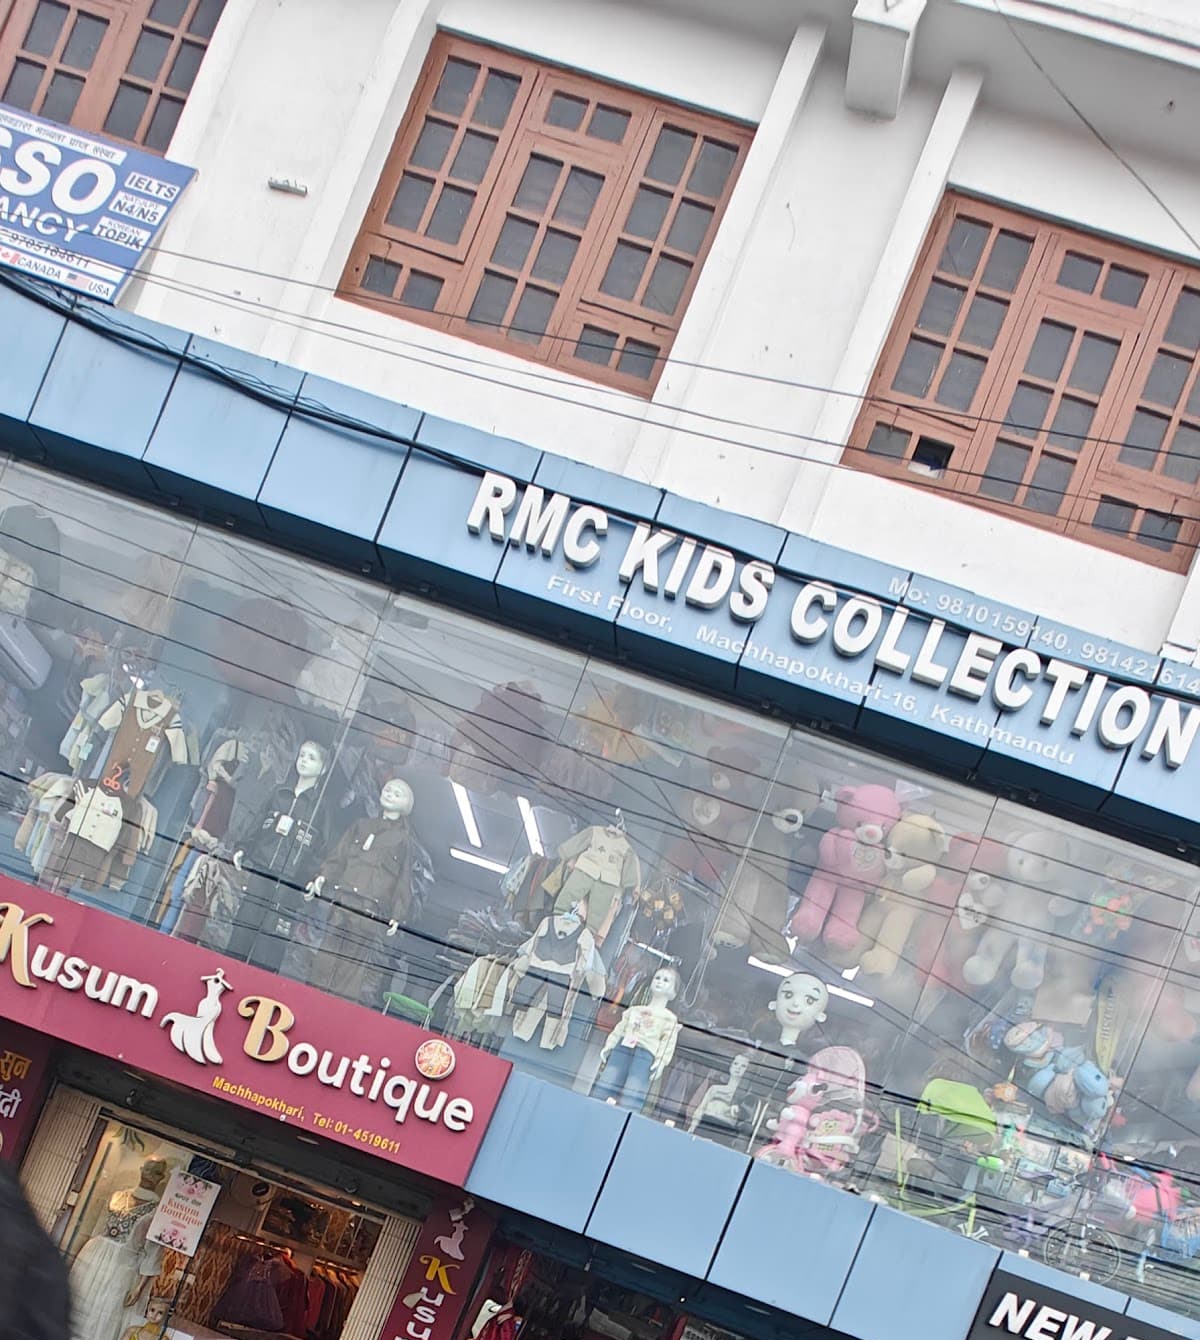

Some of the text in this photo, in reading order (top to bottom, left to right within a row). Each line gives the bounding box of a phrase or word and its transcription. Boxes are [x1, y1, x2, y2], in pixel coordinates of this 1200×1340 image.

[127, 173, 178, 199] IELTS
[112, 200, 160, 223] N4/N5
[97, 224, 144, 249] TOPIK
[17, 257, 110, 297] CANADA USA
[888, 576, 932, 605] Mo:
[466, 470, 1200, 769] RMC KIDS COLLECTION
[547, 575, 600, 606] First
[607, 596, 674, 633] Floor,
[929, 701, 1077, 766] Kathmandu
[0, 903, 475, 1132] Kusum Boutique
